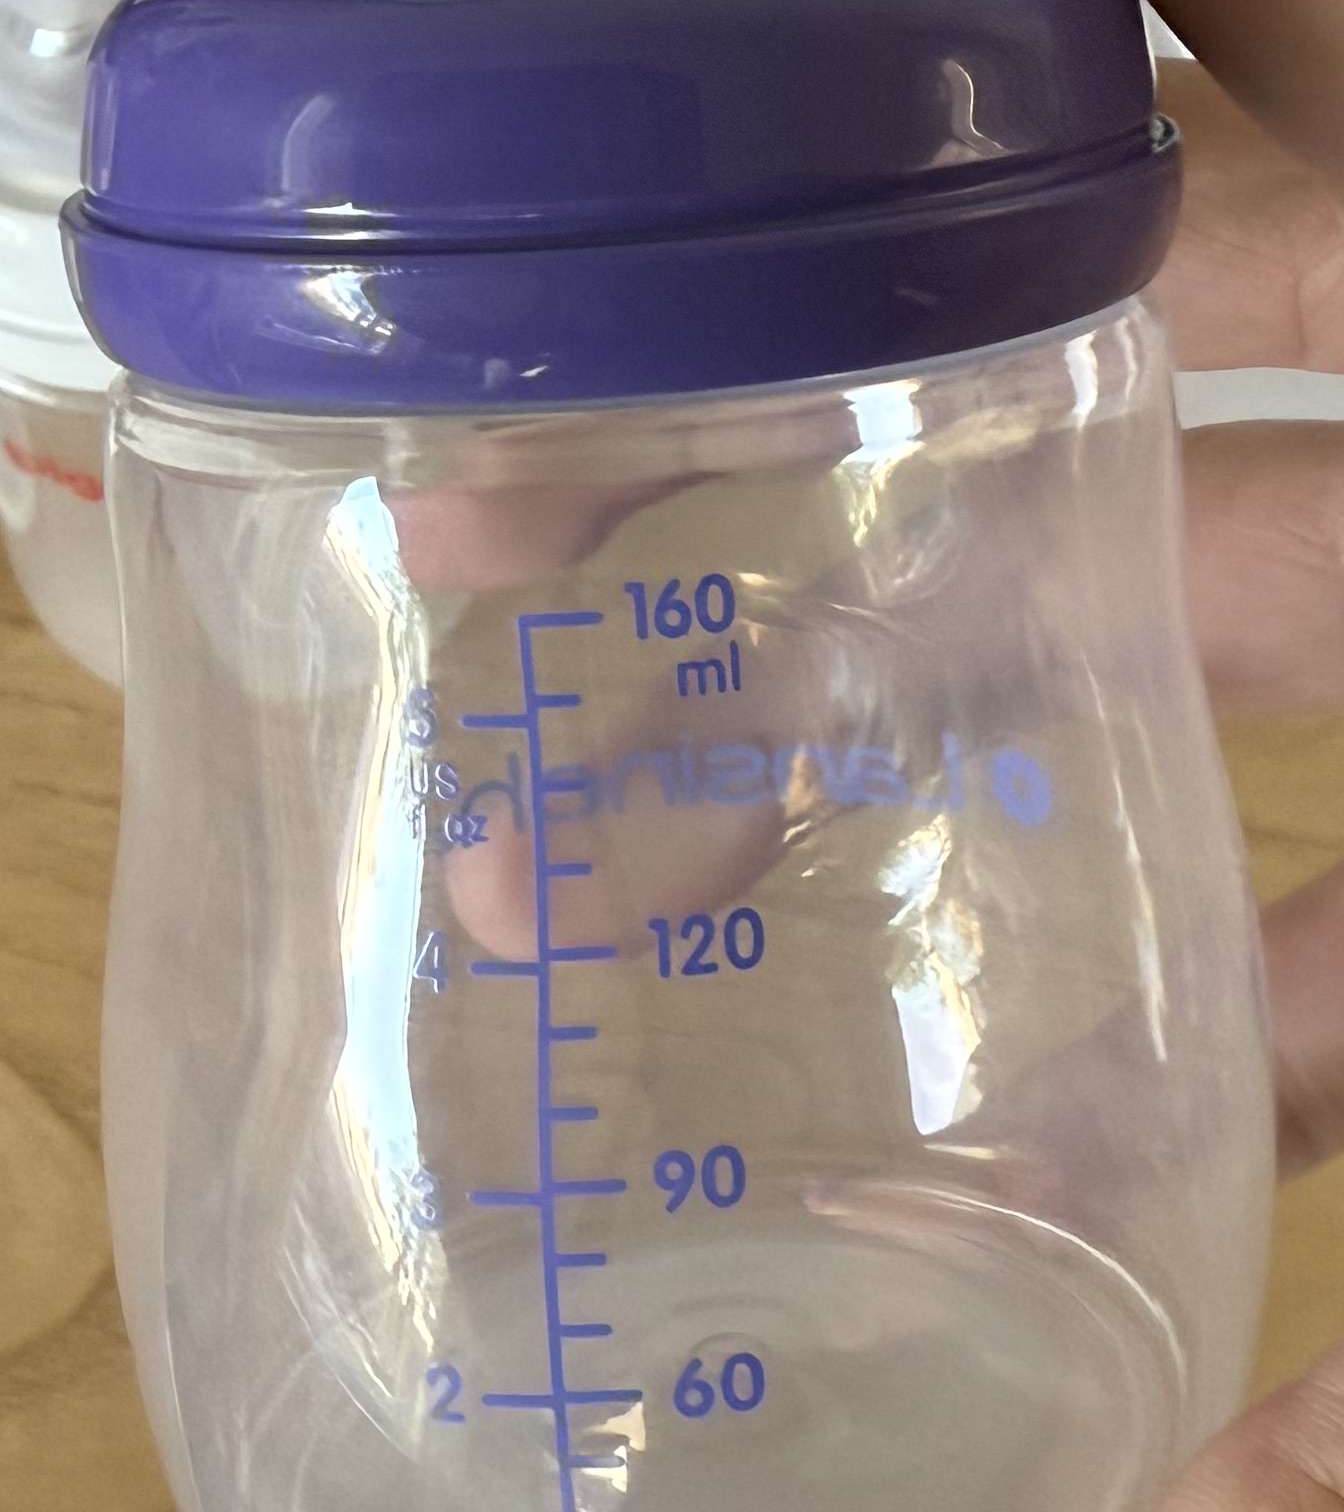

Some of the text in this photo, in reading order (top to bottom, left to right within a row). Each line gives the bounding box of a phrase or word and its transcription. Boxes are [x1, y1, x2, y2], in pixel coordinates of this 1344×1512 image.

[624, 573, 735, 640] 160
[677, 640, 742, 697] ml
[410, 760, 460, 801] US
[413, 929, 448, 994] 4
[648, 907, 765, 979] 120
[653, 1144, 746, 1213] 90
[425, 1365, 466, 1424] 2
[672, 1352, 766, 1419] 60
